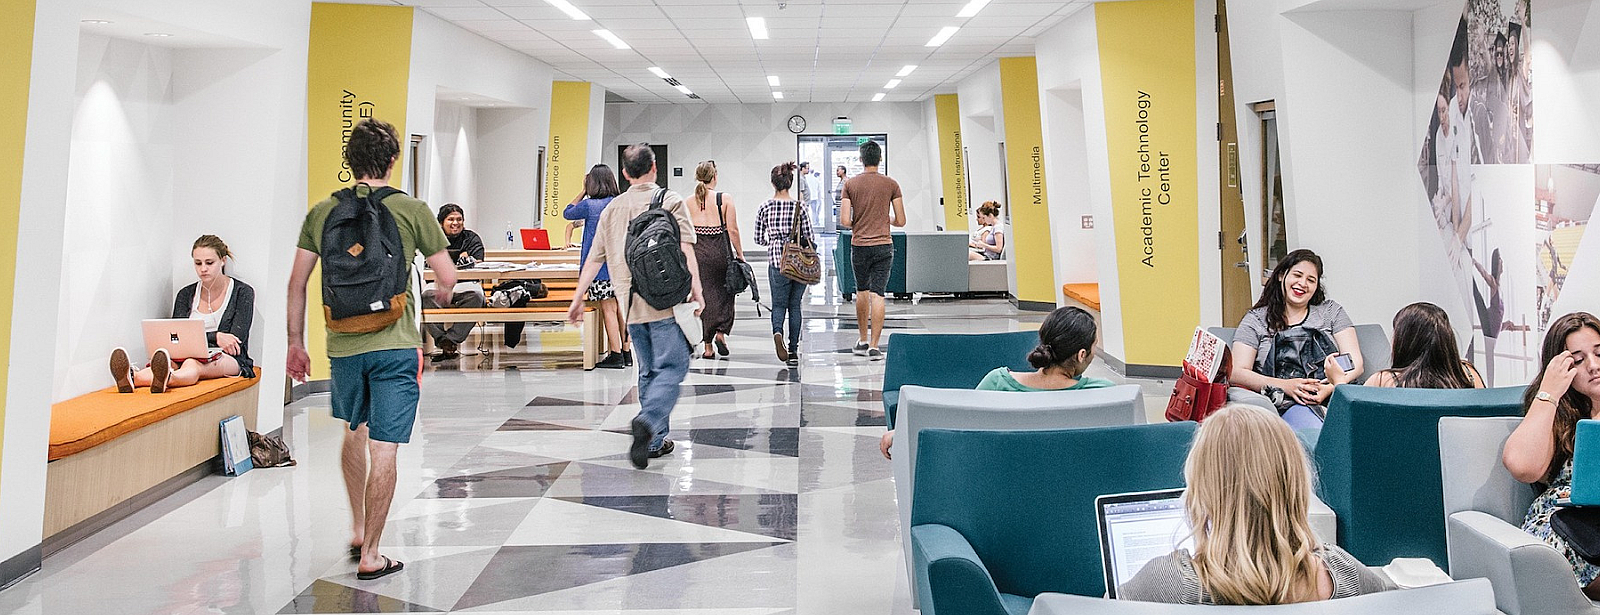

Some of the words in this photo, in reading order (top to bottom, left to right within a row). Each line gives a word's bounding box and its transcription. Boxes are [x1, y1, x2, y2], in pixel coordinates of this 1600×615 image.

[359, 101, 375, 118] E)
[552, 136, 560, 162] Room
[1136, 90, 1151, 182] Technology
[551, 166, 559, 217] Conference
[955, 177, 963, 218] Accessible
[1032, 146, 1042, 205] Multimedia
[1157, 151, 1171, 205] Center
[1138, 188, 1154, 268] Academic
